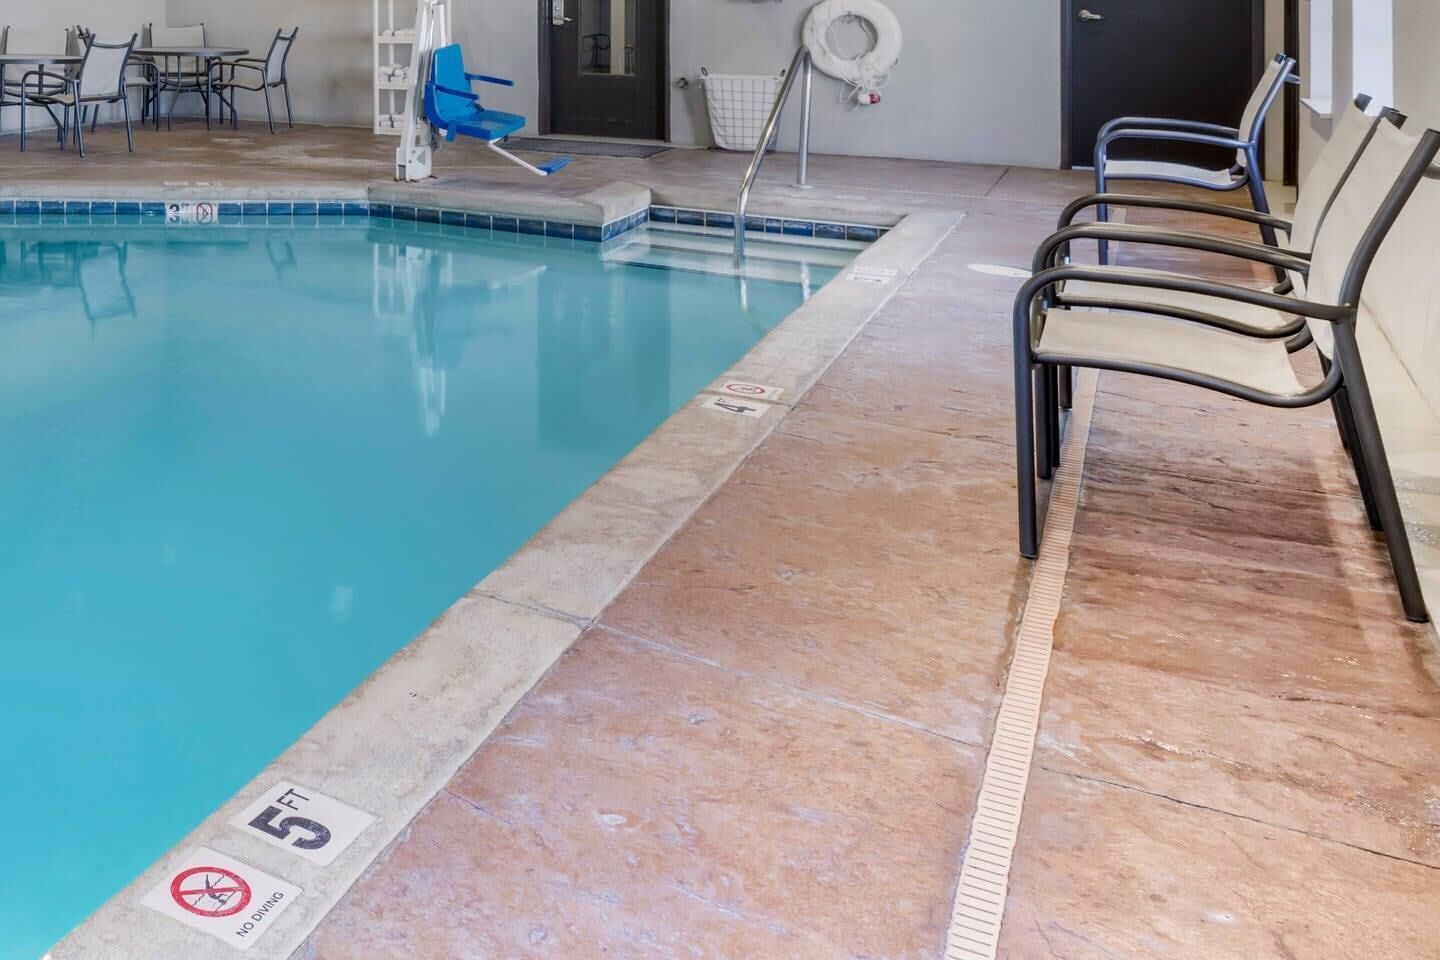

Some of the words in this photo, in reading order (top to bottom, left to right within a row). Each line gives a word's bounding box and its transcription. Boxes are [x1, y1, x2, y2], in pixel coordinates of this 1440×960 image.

[714, 402, 757, 414] 4
[276, 788, 310, 811] FT
[248, 805, 332, 850] 5
[236, 920, 254, 937] NO
[251, 891, 285, 923] DIVING
